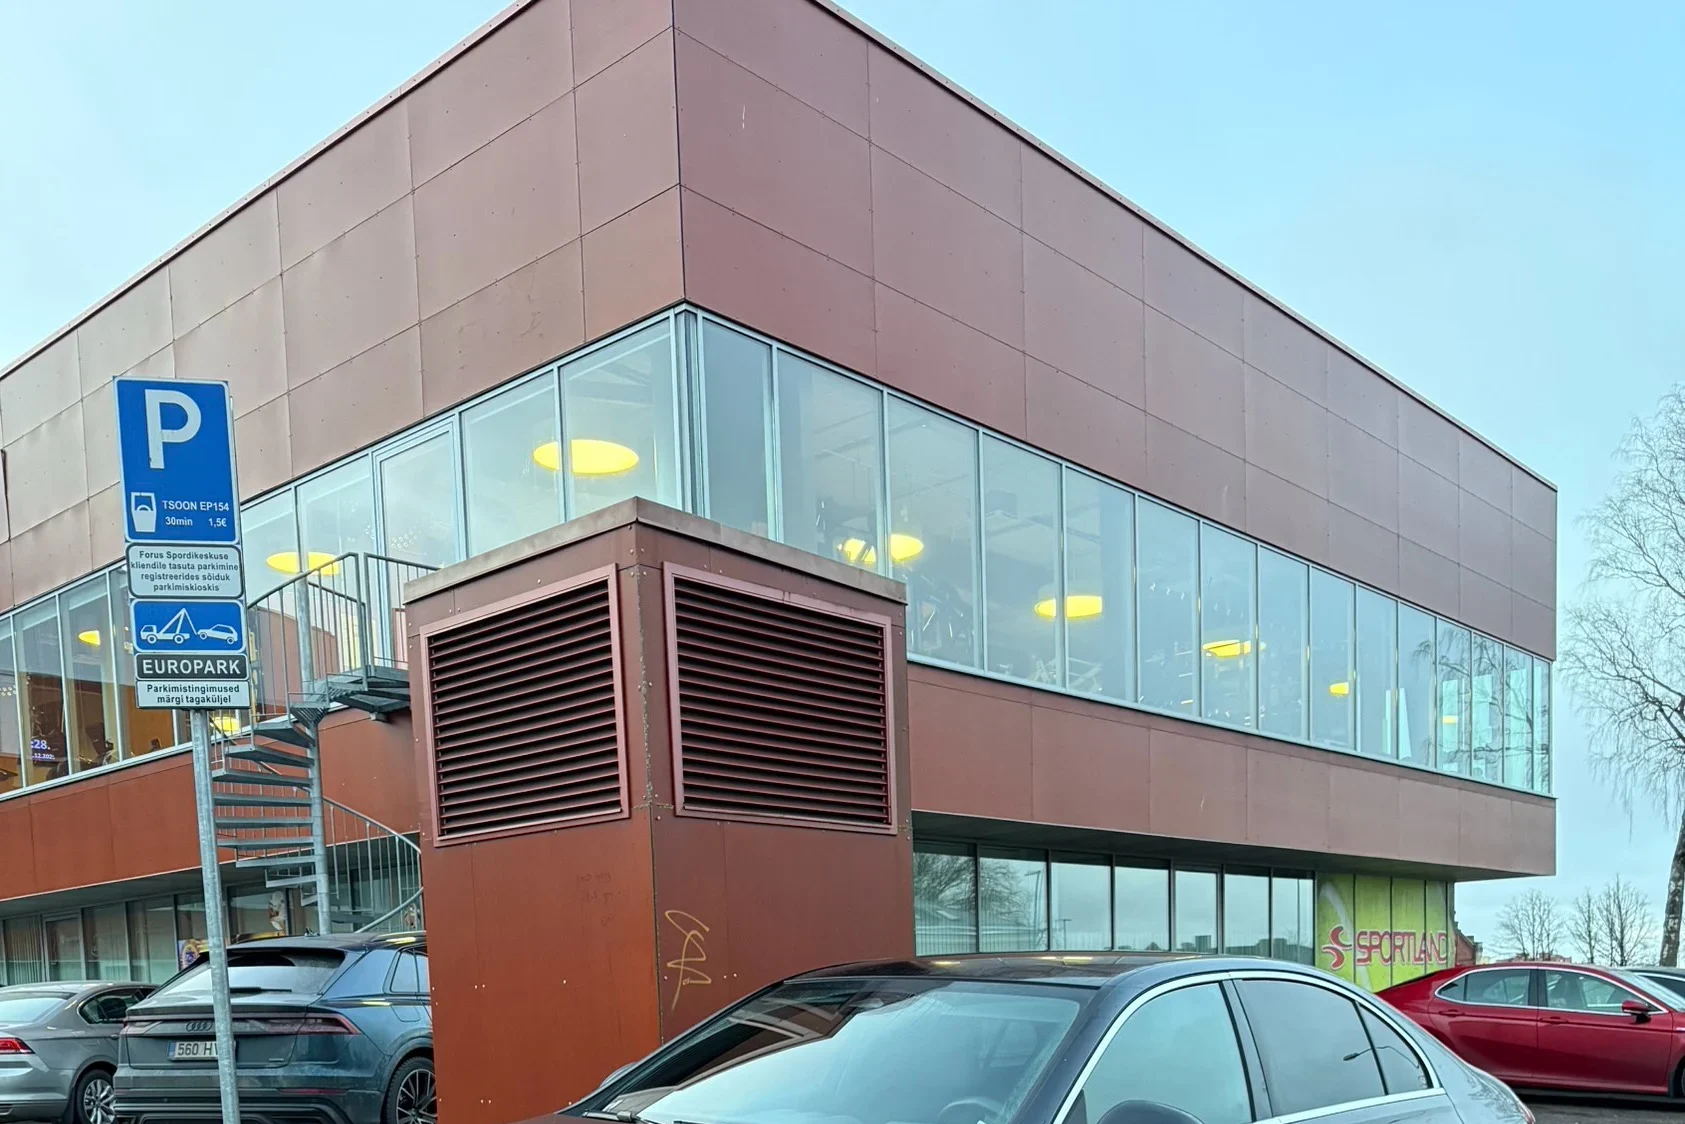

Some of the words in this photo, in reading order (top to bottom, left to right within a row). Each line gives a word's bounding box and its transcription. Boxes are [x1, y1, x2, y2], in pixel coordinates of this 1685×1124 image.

[145, 388, 202, 470] P
[162, 500, 197, 511] TSOON
[199, 501, 230, 512] EP154
[165, 517, 193, 526] 30min
[208, 518, 227, 528] 1,5€
[139, 550, 164, 559] Forus
[166, 551, 229, 562] Spordikeskuse
[130, 559, 166, 570] kliendile
[168, 560, 195, 570] tasuta
[197, 561, 239, 572] parkimine
[140, 570, 200, 583] registreerides
[202, 571, 230, 581] sõiduk
[153, 582, 220, 593] parkimiskioskis
[142, 659, 241, 675] EUROPARK
[147, 684, 240, 695] Parkimistingimused
[157, 695, 184, 705] märgi
[185, 694, 232, 705] tagaküljel
[1355, 930, 1448, 966] SPORTLAND
[178, 1043, 199, 1056] 560
